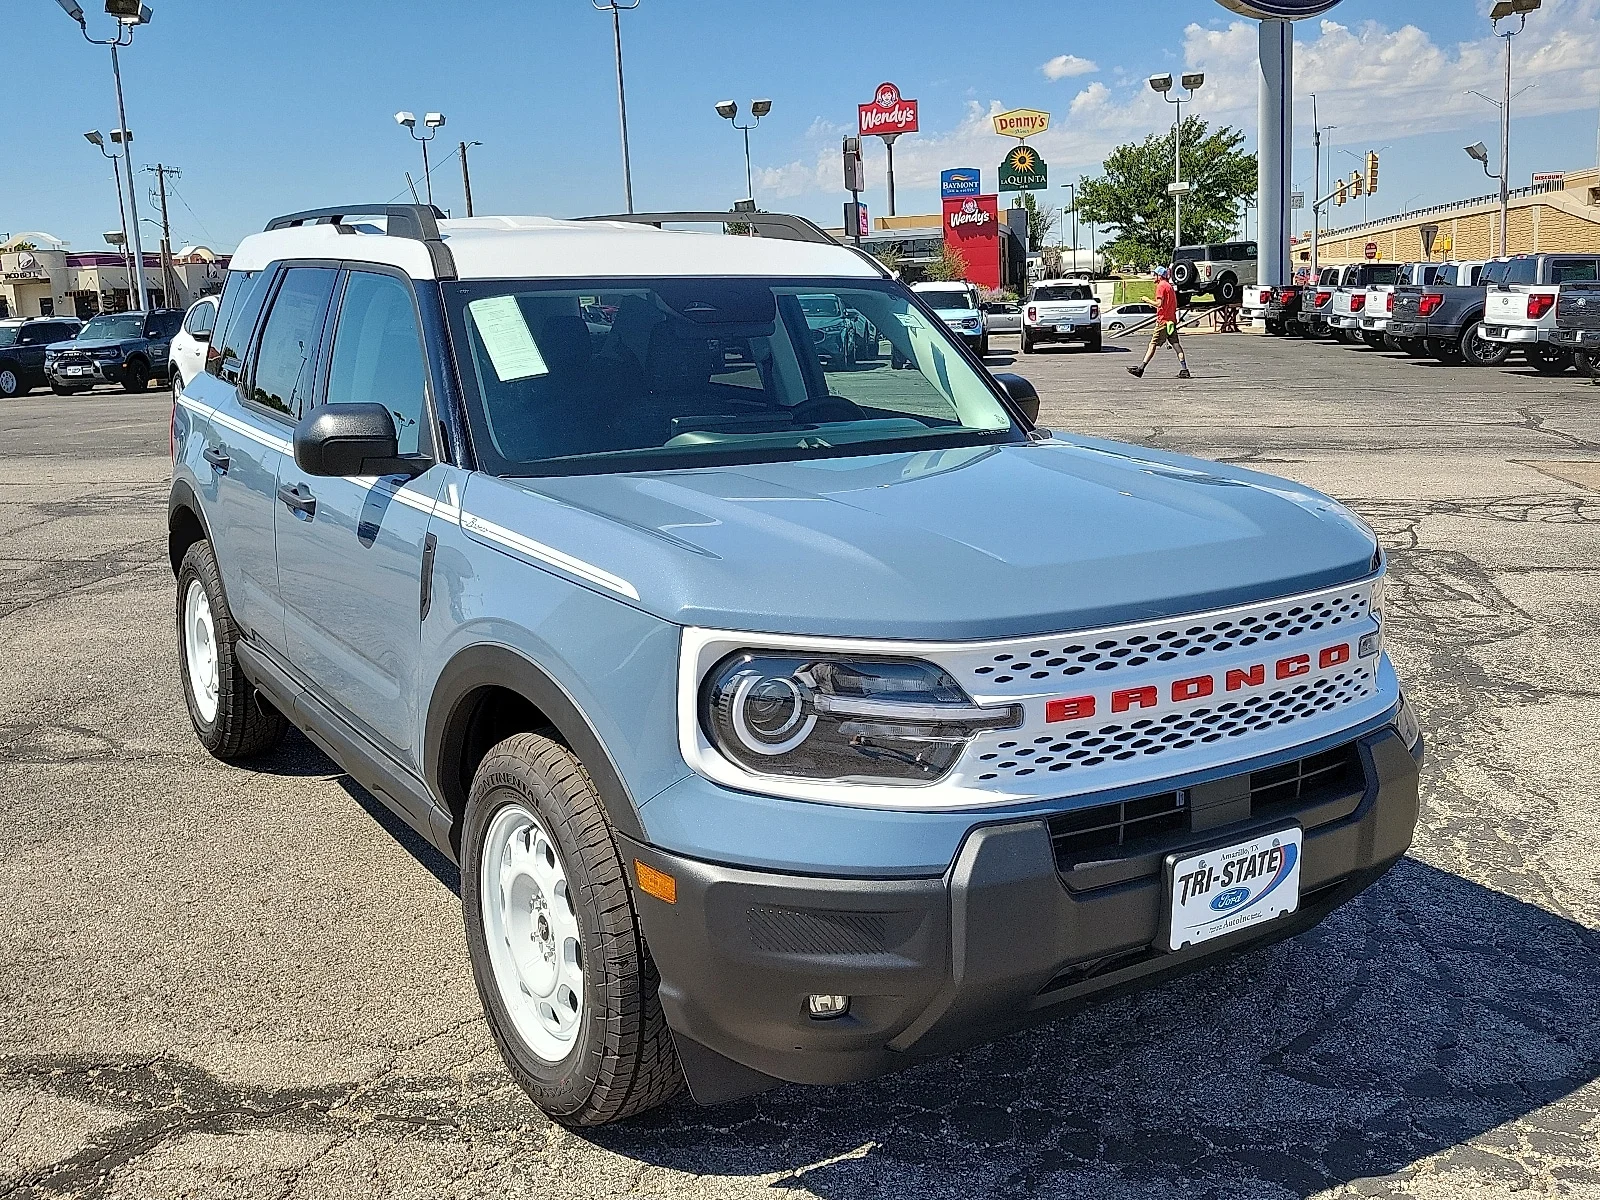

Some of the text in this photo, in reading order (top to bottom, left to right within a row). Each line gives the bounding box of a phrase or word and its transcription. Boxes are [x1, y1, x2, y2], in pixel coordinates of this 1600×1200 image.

[861, 104, 915, 131] Wendy's
[999, 114, 1046, 130] Denny's
[942, 181, 979, 190] BAYMONT
[1007, 174, 1047, 186] QUINTA
[950, 210, 990, 227] Wendy's
[1045, 643, 1350, 724] BRONCO
[1178, 846, 1281, 907] TRI-STATE
[1219, 891, 1243, 907] Ford
